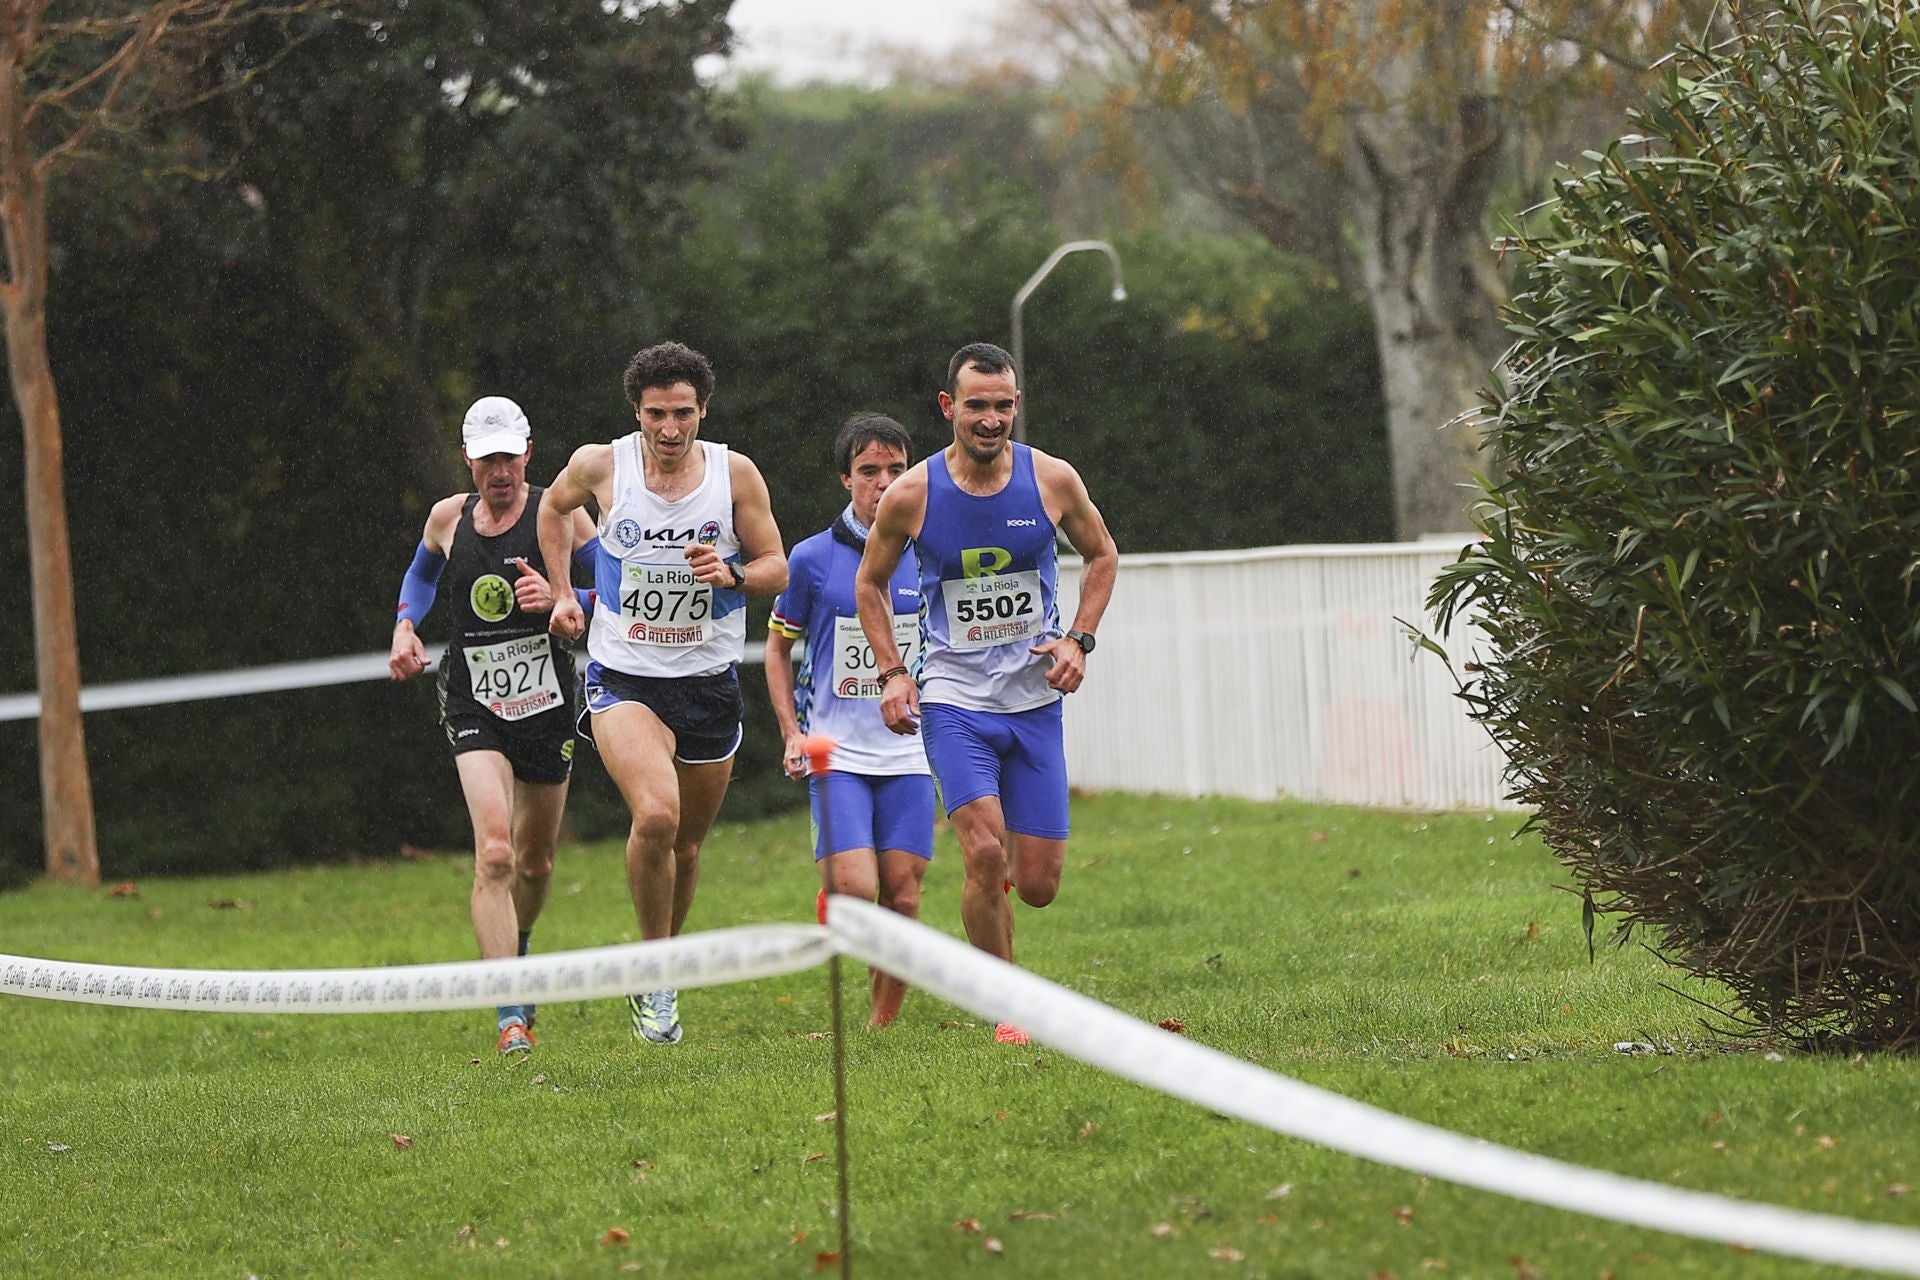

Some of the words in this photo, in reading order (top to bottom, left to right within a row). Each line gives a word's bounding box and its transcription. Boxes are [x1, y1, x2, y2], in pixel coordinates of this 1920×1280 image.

[644, 528, 695, 541] KIA
[961, 547, 1013, 579] R
[648, 570, 663, 584] La
[981, 584, 992, 593] La
[994, 580, 1019, 591] Rioja
[622, 588, 710, 622] 4975
[957, 591, 1033, 622] 5502
[648, 630, 703, 644] ATLETISMO
[840, 624, 862, 632] Gobier
[984, 624, 1029, 641] ATLETISMO
[489, 650, 506, 664] La
[508, 641, 542, 660] Rioja
[845, 642, 911, 670] 307
[475, 654, 549, 699] 4927
[505, 696, 554, 718] ATLETISMO
